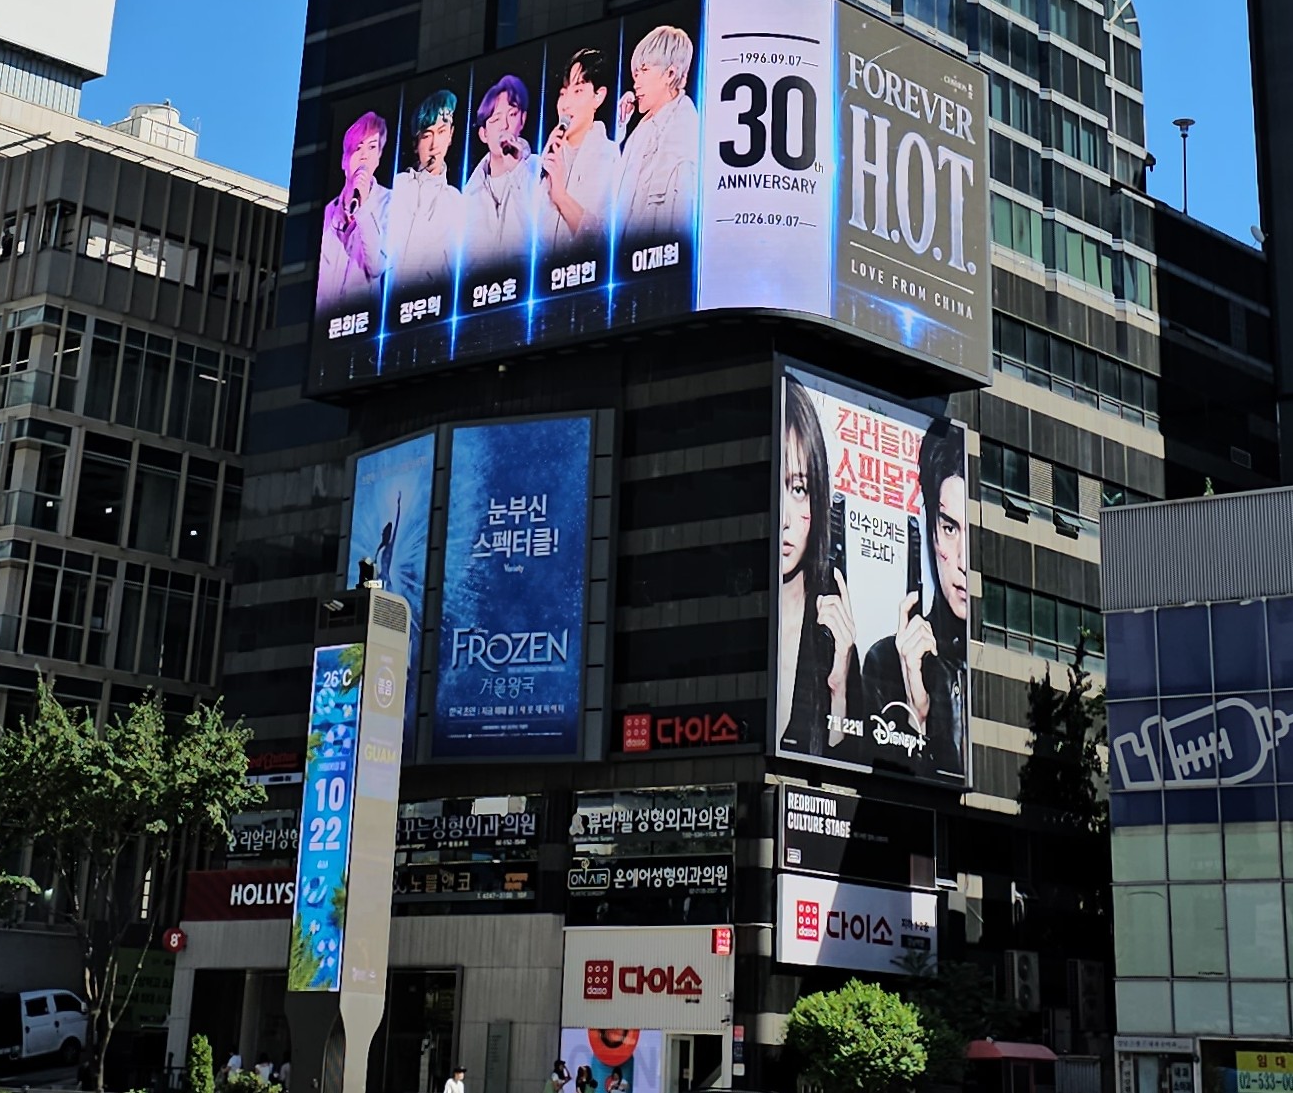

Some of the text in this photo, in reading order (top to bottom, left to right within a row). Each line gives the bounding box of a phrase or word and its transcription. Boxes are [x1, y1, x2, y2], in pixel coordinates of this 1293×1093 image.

[739, 53, 802, 67] 1996.09.07
[847, 51, 976, 145] FOREVER
[717, 173, 817, 196] ANNIVERSARY
[848, 104, 977, 276] H.O.T.
[734, 212, 800, 228] 2026.09.07
[632, 242, 679, 272] 이재원
[551, 260, 597, 291] 안칠현
[850, 258, 974, 320] LOVE FROM CHINA
[472, 278, 517, 307] 안승호
[399, 295, 441, 324] 장우혁
[328, 311, 370, 339] 문희준
[834, 406, 923, 465] 킬러들의
[833, 446, 922, 516] 쇼핑몰2
[487, 493, 547, 526] 눈부신
[849, 510, 906, 545] 인수인계는
[471, 528, 559, 559] 스펙터클!
[860, 537, 895, 565] 끝났다
[451, 627, 569, 673] FROZEN
[479, 676, 535, 699] 겨울왕국
[656, 712, 739, 744] 다이소
[365, 744, 396, 764] GUAM
[315, 776, 346, 812] 10
[787, 791, 837, 817] REDBUTTON
[309, 816, 342, 852] 22
[787, 811, 824, 834] CULTURE
[825, 818, 851, 839] STAGE
[613, 865, 729, 889] 온에어성형외과의원
[230, 882, 295, 906] HOLLYS
[826, 910, 894, 946] 다이소
[618, 965, 703, 995] 다이소
